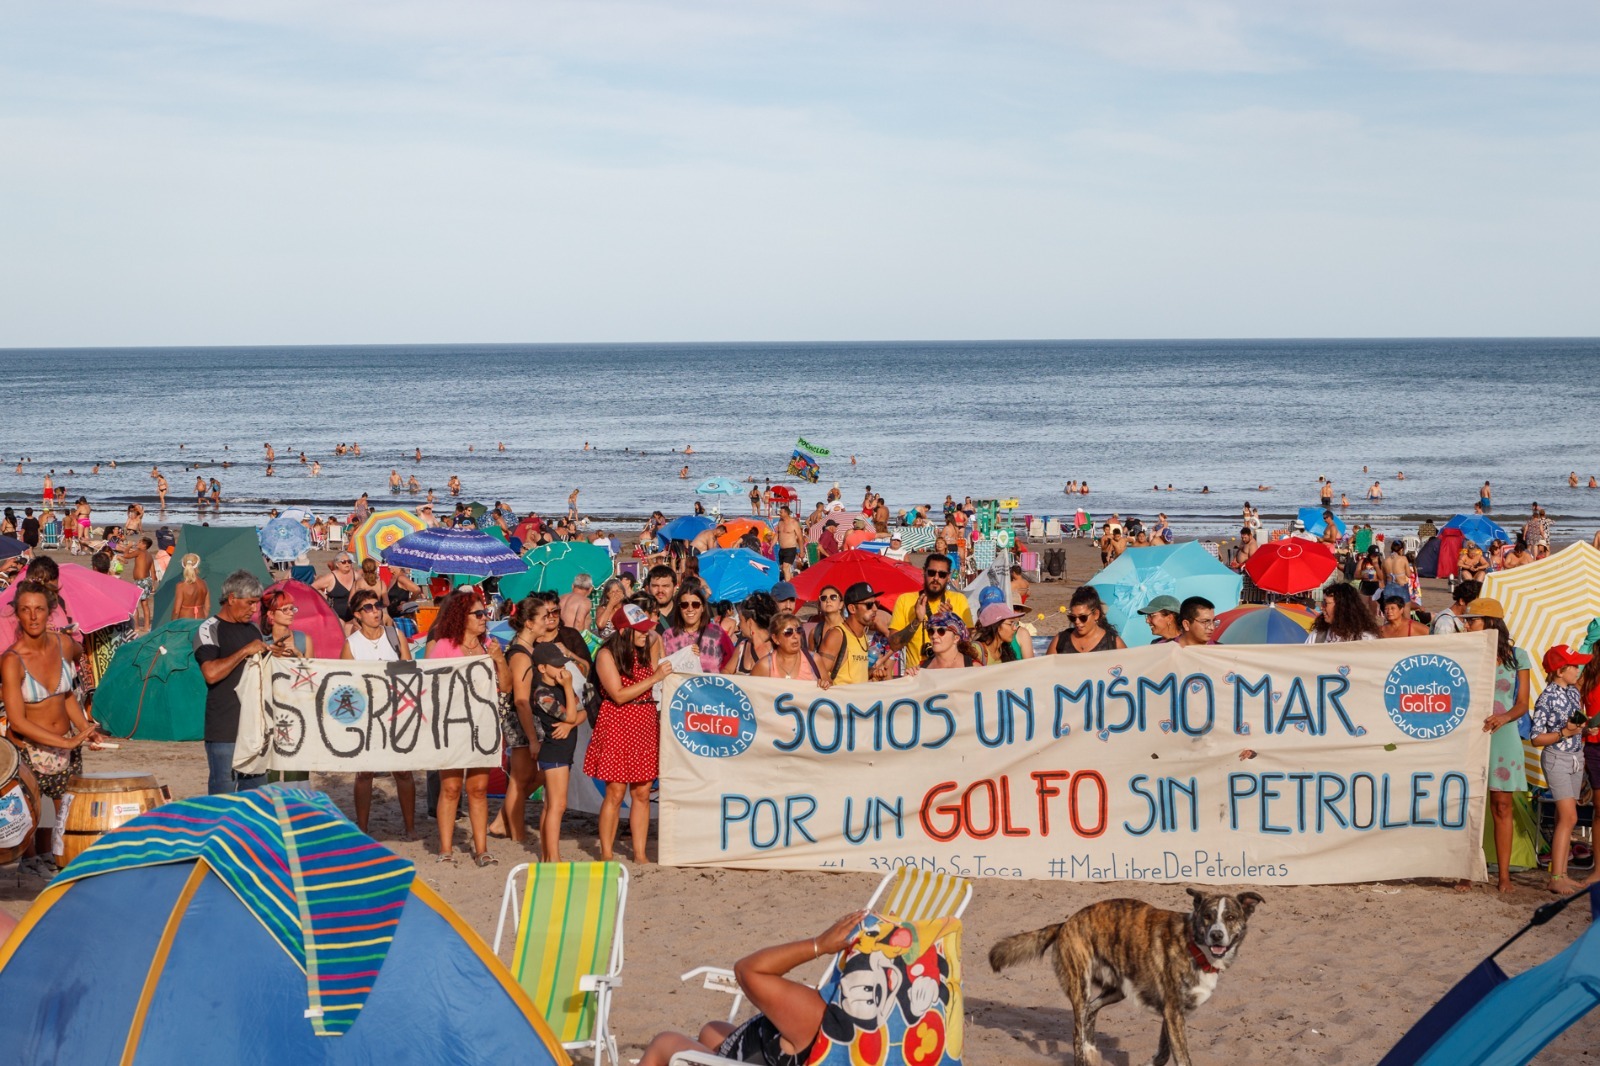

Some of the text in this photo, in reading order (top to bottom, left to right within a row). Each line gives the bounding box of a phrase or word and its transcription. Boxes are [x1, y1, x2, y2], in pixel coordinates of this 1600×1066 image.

[1385, 655, 1466, 695] DEFENDAMOS
[1400, 680, 1451, 695] nuestro
[670, 676, 755, 721] DEFENDAMOS
[686, 701, 740, 718] nuestro
[773, 672, 1357, 753] SOMOS UN MISMO MAR
[1401, 695, 1447, 713] Golfo
[672, 721, 754, 757] DEFENDAMOS
[687, 713, 733, 735] Golfo
[1388, 706, 1466, 739] DEFENDAMOS
[720, 771, 1470, 852] POR UN GOLFO SIN PETROLEO
[1048, 850, 1290, 881] #MarLibreDePetroleras
